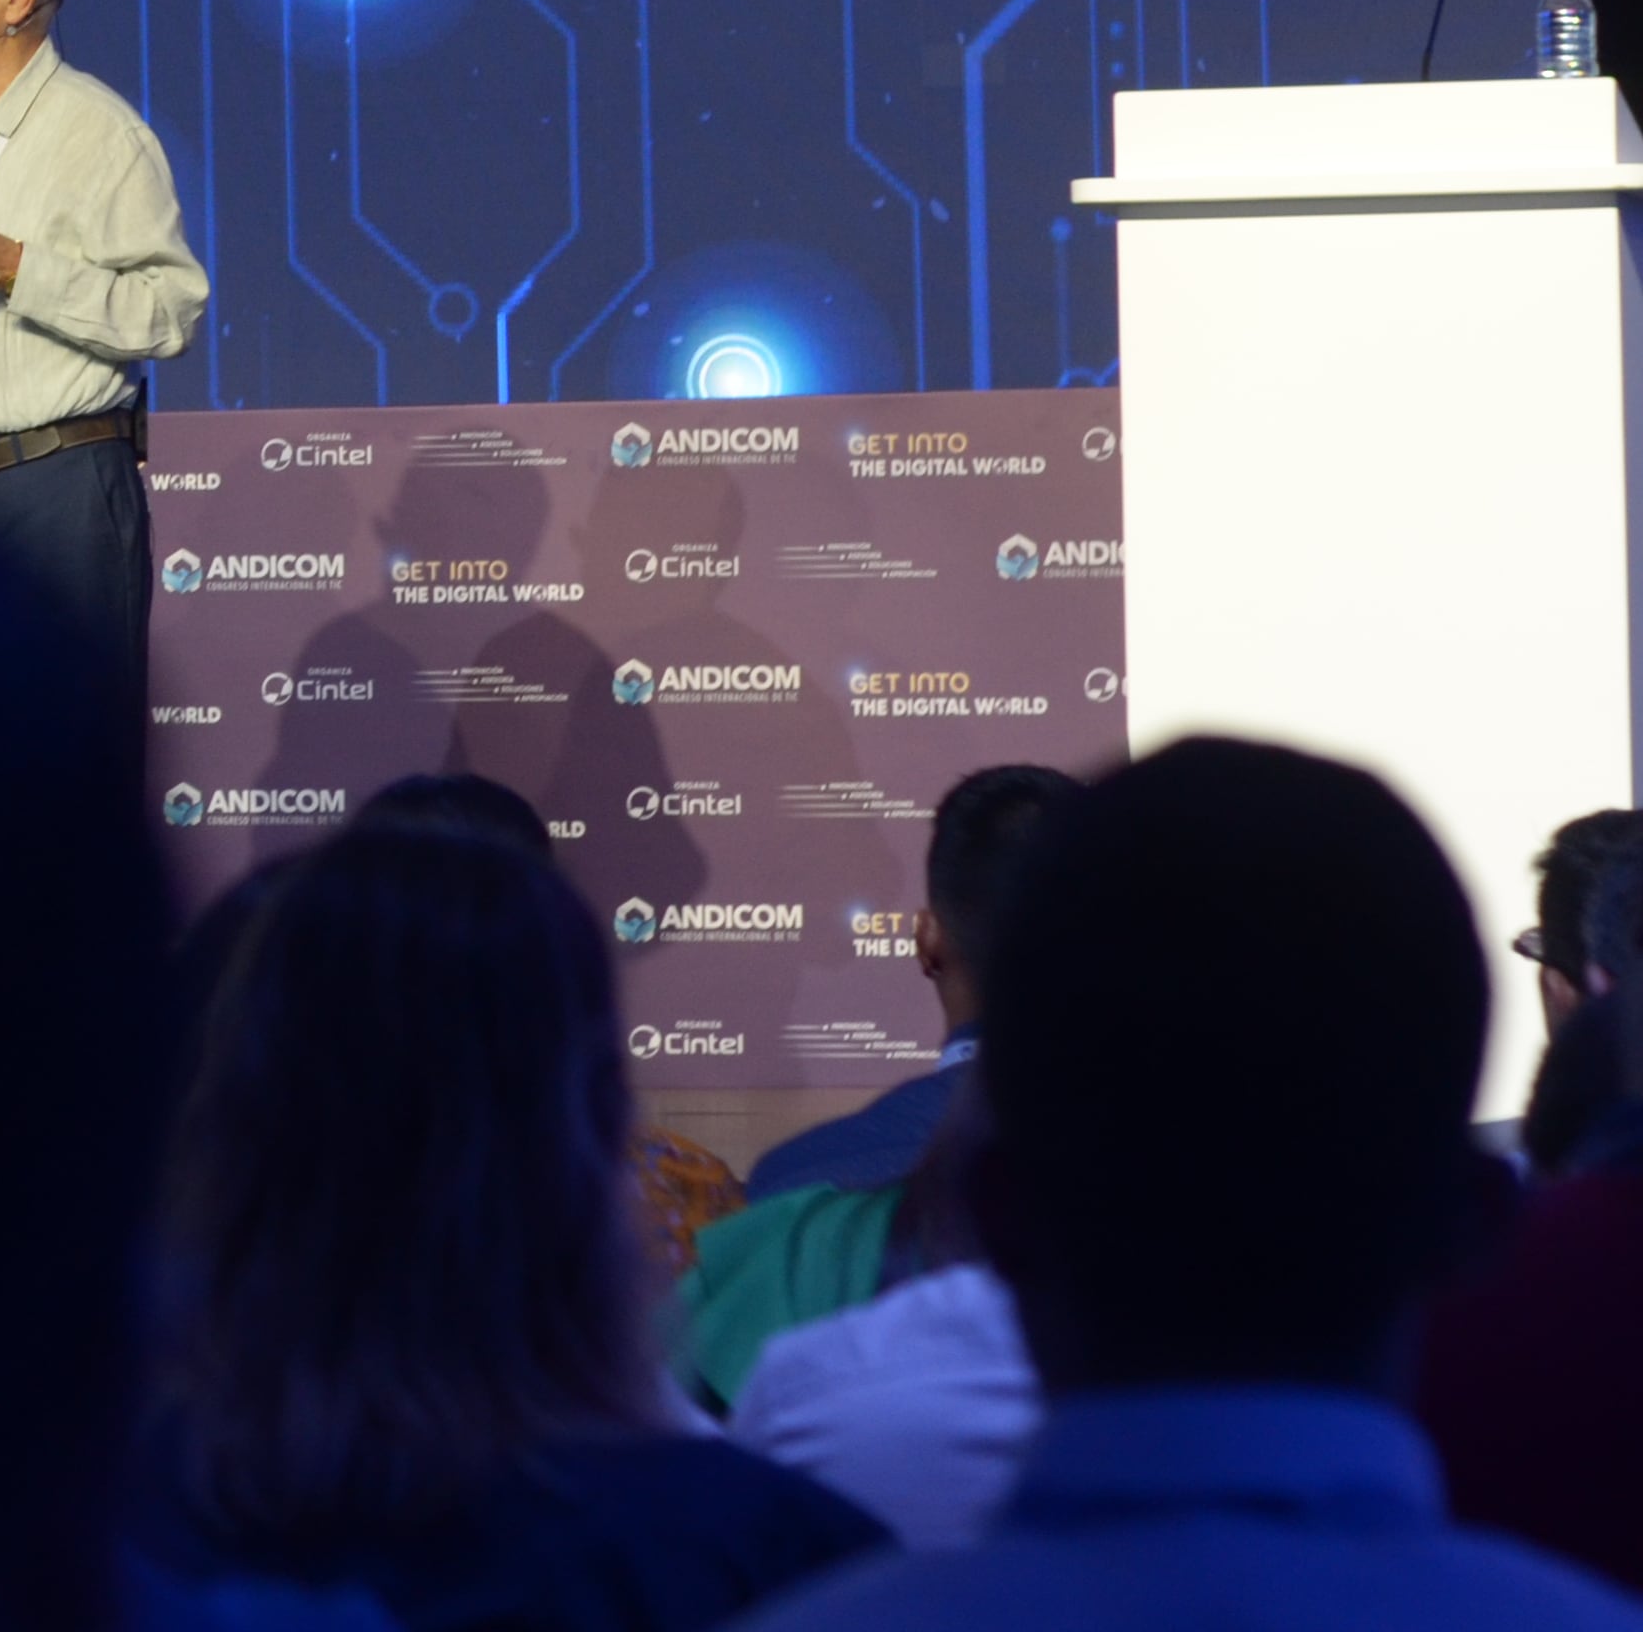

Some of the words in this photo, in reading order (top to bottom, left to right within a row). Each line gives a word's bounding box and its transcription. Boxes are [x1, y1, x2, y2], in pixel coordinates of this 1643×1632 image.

[657, 426, 799, 454] ANDICOM
[848, 434, 899, 455] GET
[907, 432, 968, 454] INTO
[296, 445, 373, 466] Cintel
[849, 459, 886, 478] THE
[890, 458, 968, 477] DIGITAL
[972, 456, 1047, 475] WORLD
[150, 473, 221, 491] WORLD
[206, 553, 345, 579] ANDICOM
[392, 561, 441, 582] GET
[450, 560, 509, 581] INTO
[661, 555, 740, 578] Cintel
[393, 586, 428, 604] THE
[432, 585, 509, 603] DIGITAL
[512, 583, 585, 602] WORLD
[658, 664, 801, 691] ANDICOM
[849, 673, 901, 695] GET
[909, 672, 970, 693] INTO
[297, 679, 374, 700] Cintel
[151, 706, 221, 724] WORLD
[851, 699, 888, 717] THE
[892, 698, 970, 716] DIGITAL
[974, 696, 1049, 715] WORLD
[206, 788, 346, 814] ANDICOM
[662, 793, 742, 815] Cintel
[548, 820, 586, 838] RLD
[660, 903, 803, 930] ANDICOM
[851, 913, 903, 935] GET
[853, 939, 890, 957] THE
[664, 1032, 745, 1055] Cintel
